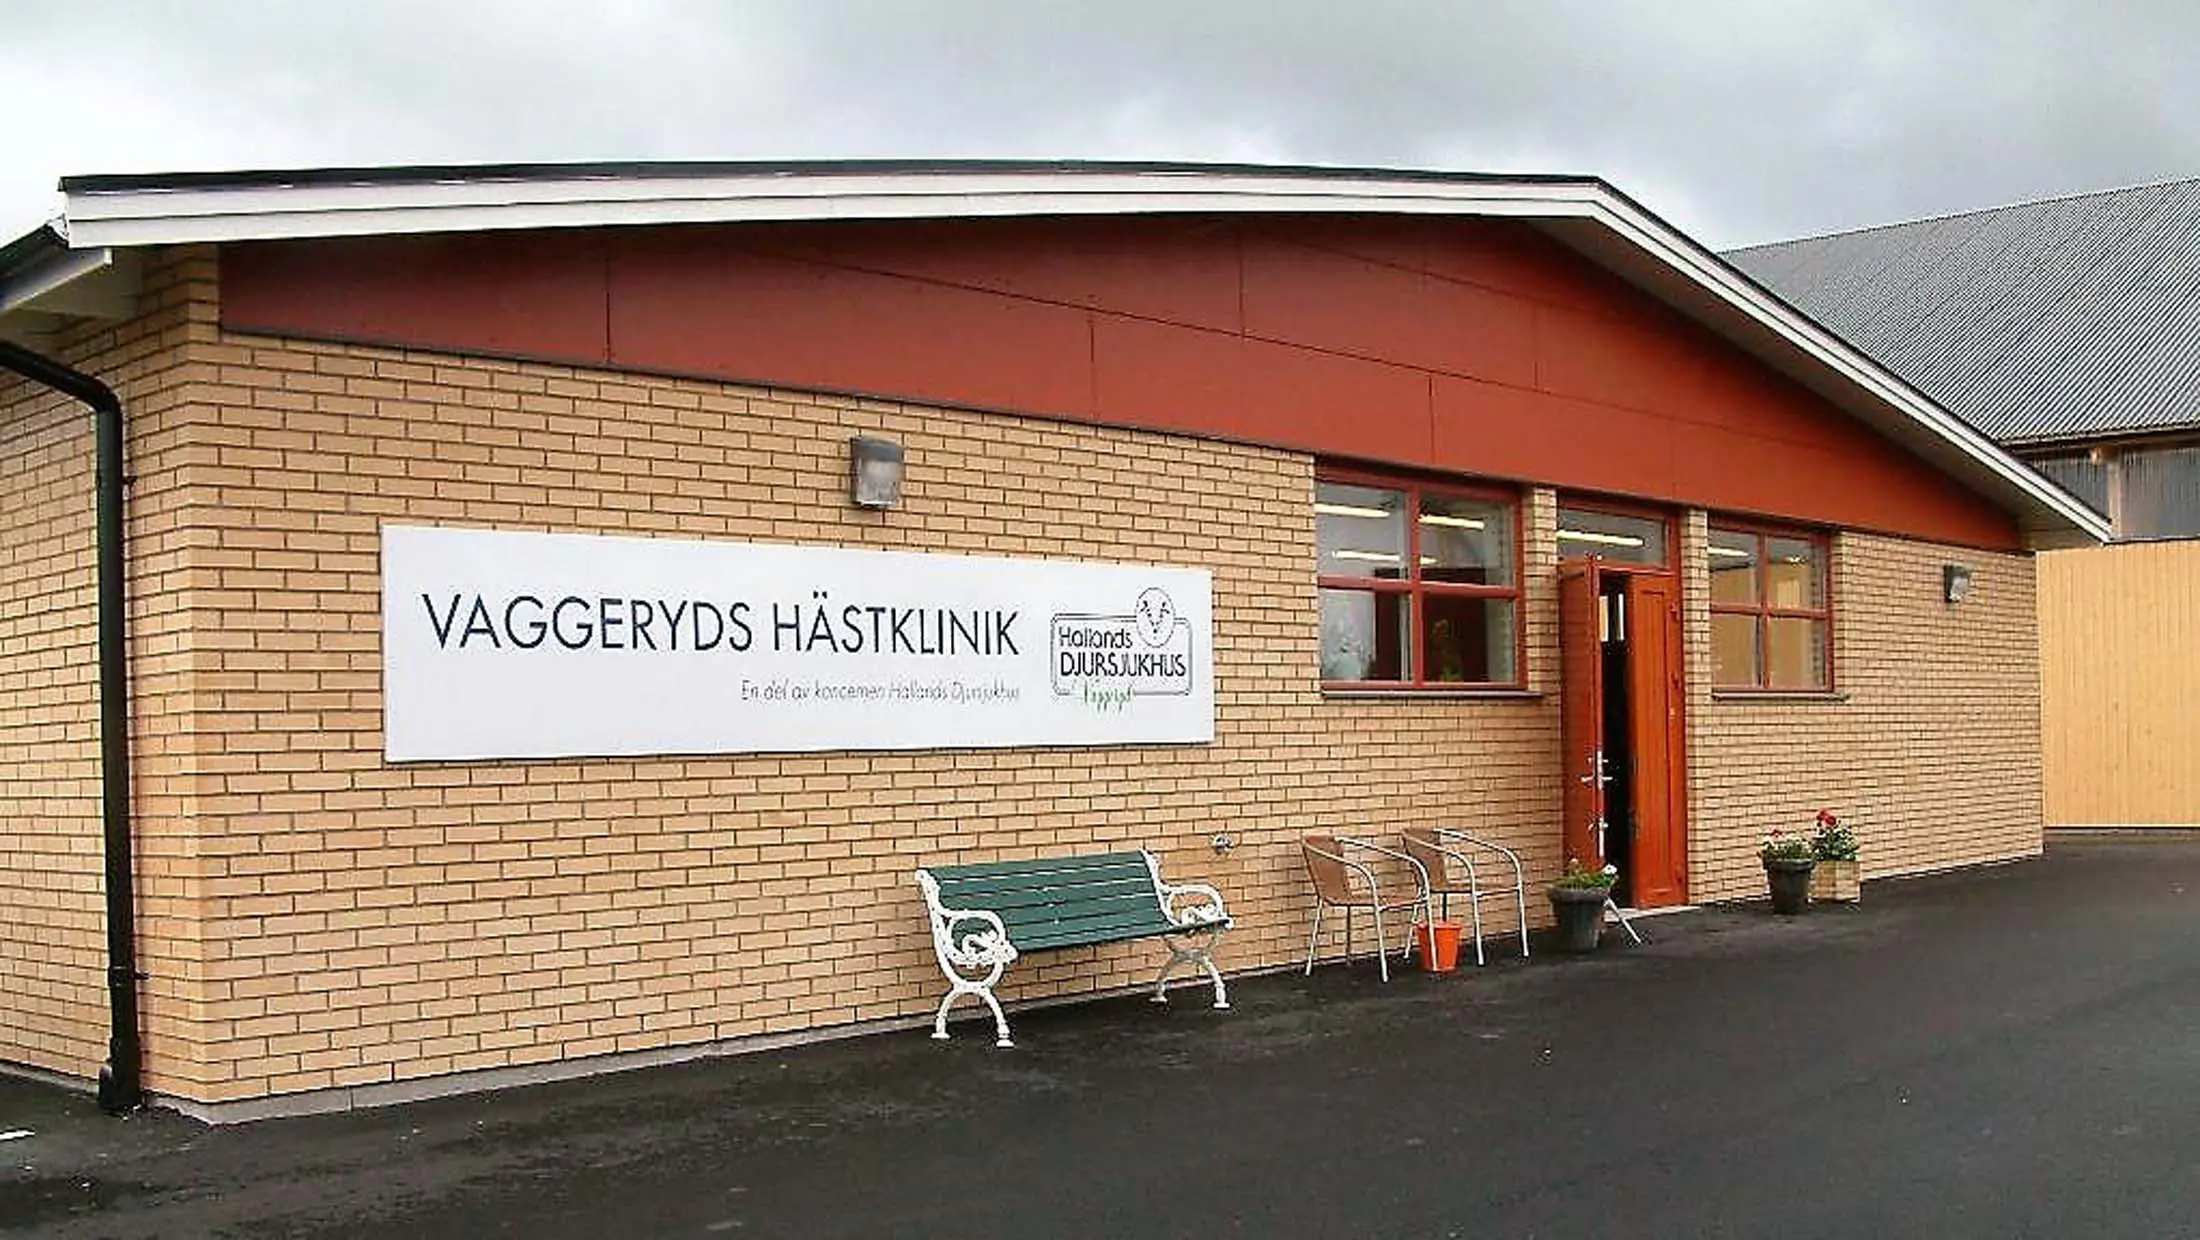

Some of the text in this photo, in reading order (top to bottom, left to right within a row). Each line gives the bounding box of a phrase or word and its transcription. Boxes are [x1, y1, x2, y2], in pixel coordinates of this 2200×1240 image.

[422, 591, 1021, 655] VAGGERYDS HÄSTKLINIK
[1058, 626, 1134, 649] Hallands
[1060, 651, 1187, 677] DJURSJUKHUS
[742, 679, 759, 701] En
[763, 678, 789, 701] del
[791, 685, 811, 701] av
